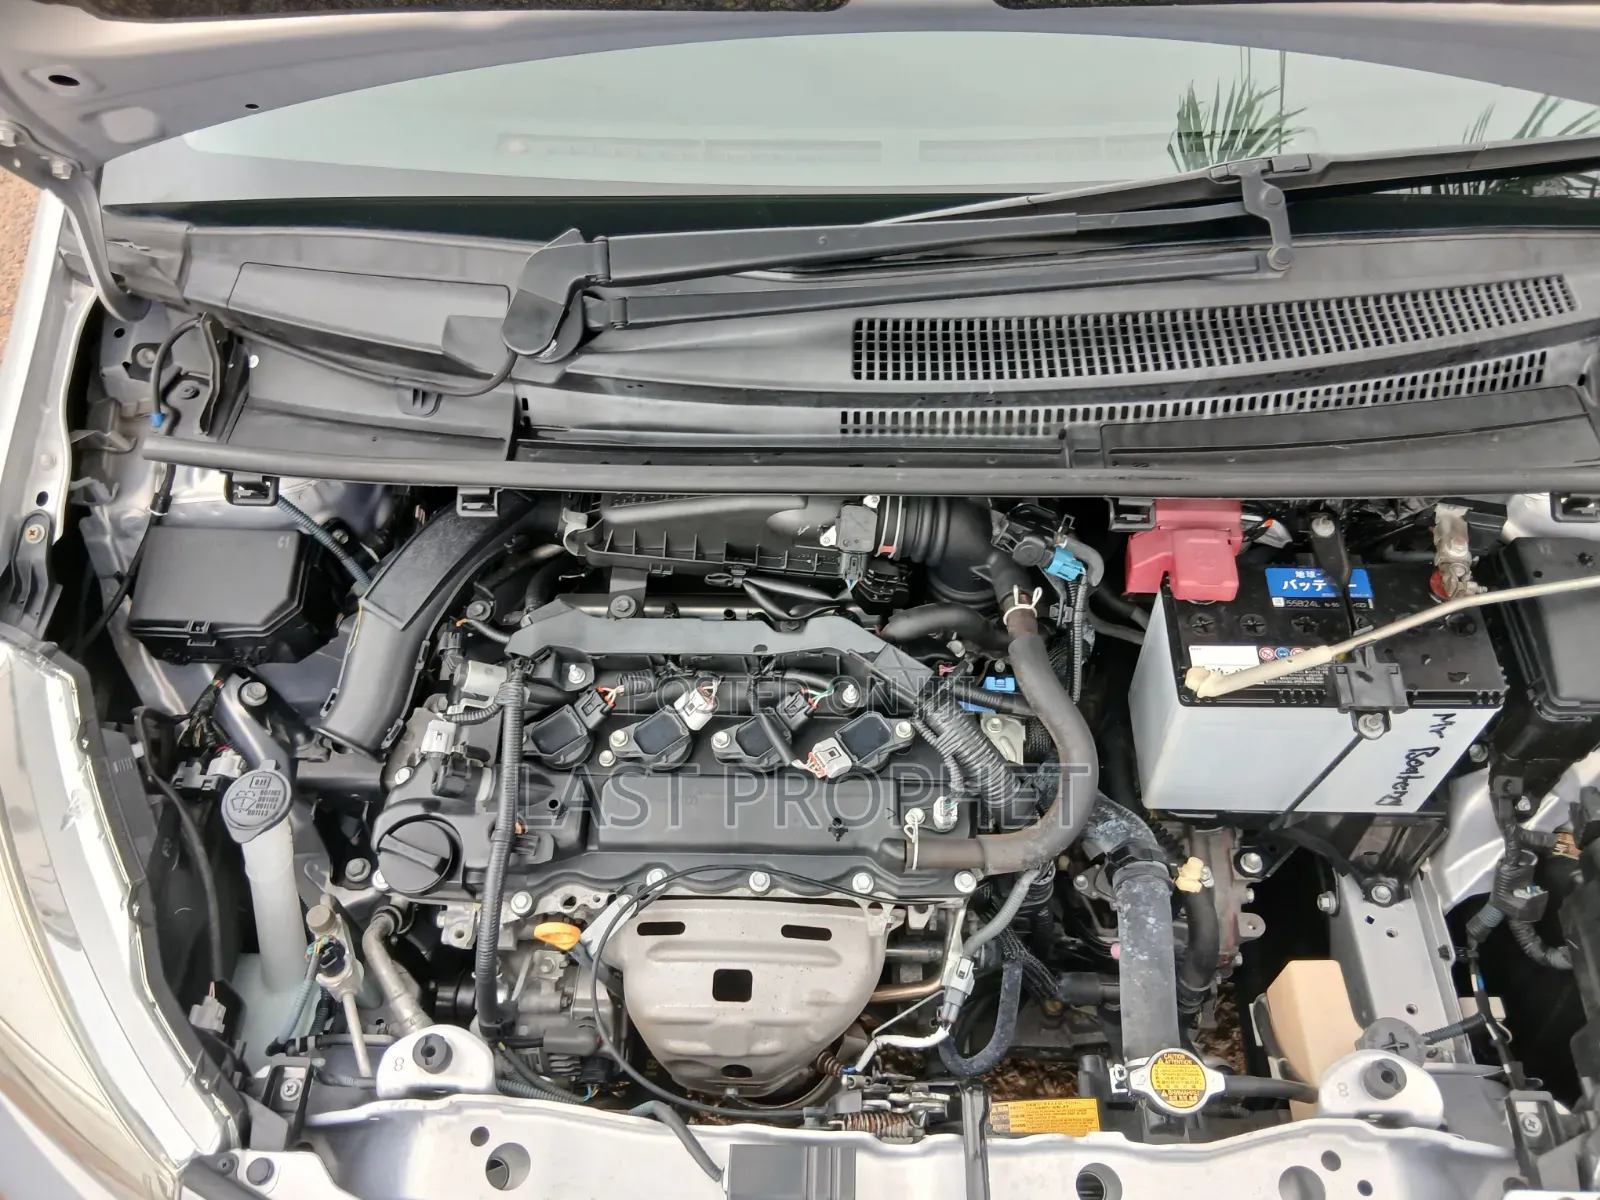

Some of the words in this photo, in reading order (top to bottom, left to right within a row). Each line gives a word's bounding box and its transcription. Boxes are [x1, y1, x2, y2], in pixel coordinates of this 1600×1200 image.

[1282, 578, 1358, 592] バッテー
[1429, 713, 1457, 739] Mr
